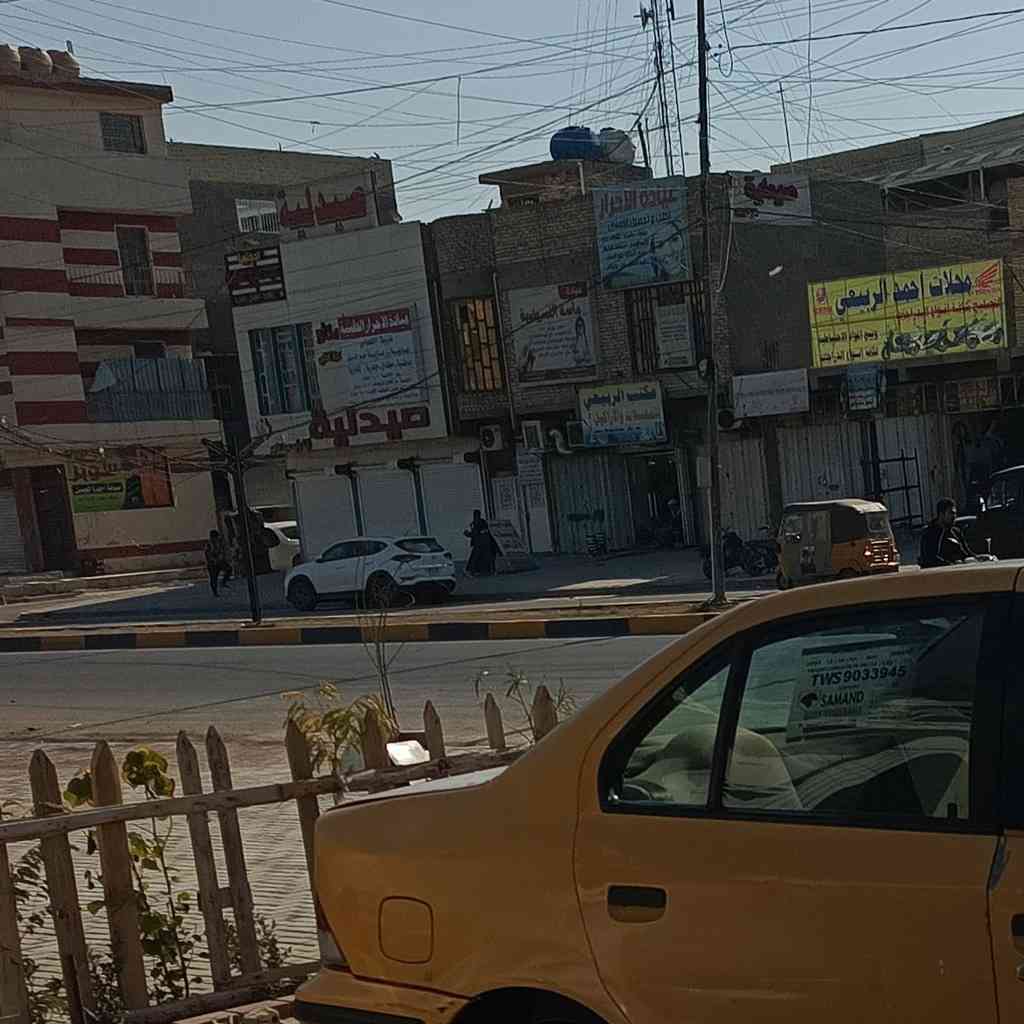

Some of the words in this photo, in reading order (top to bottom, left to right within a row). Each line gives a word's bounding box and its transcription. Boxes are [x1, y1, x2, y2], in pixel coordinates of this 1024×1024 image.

[929, 269, 972, 297] محلات
[310, 406, 430, 448] صيدلية
[820, 690, 865, 707] SAMAND
